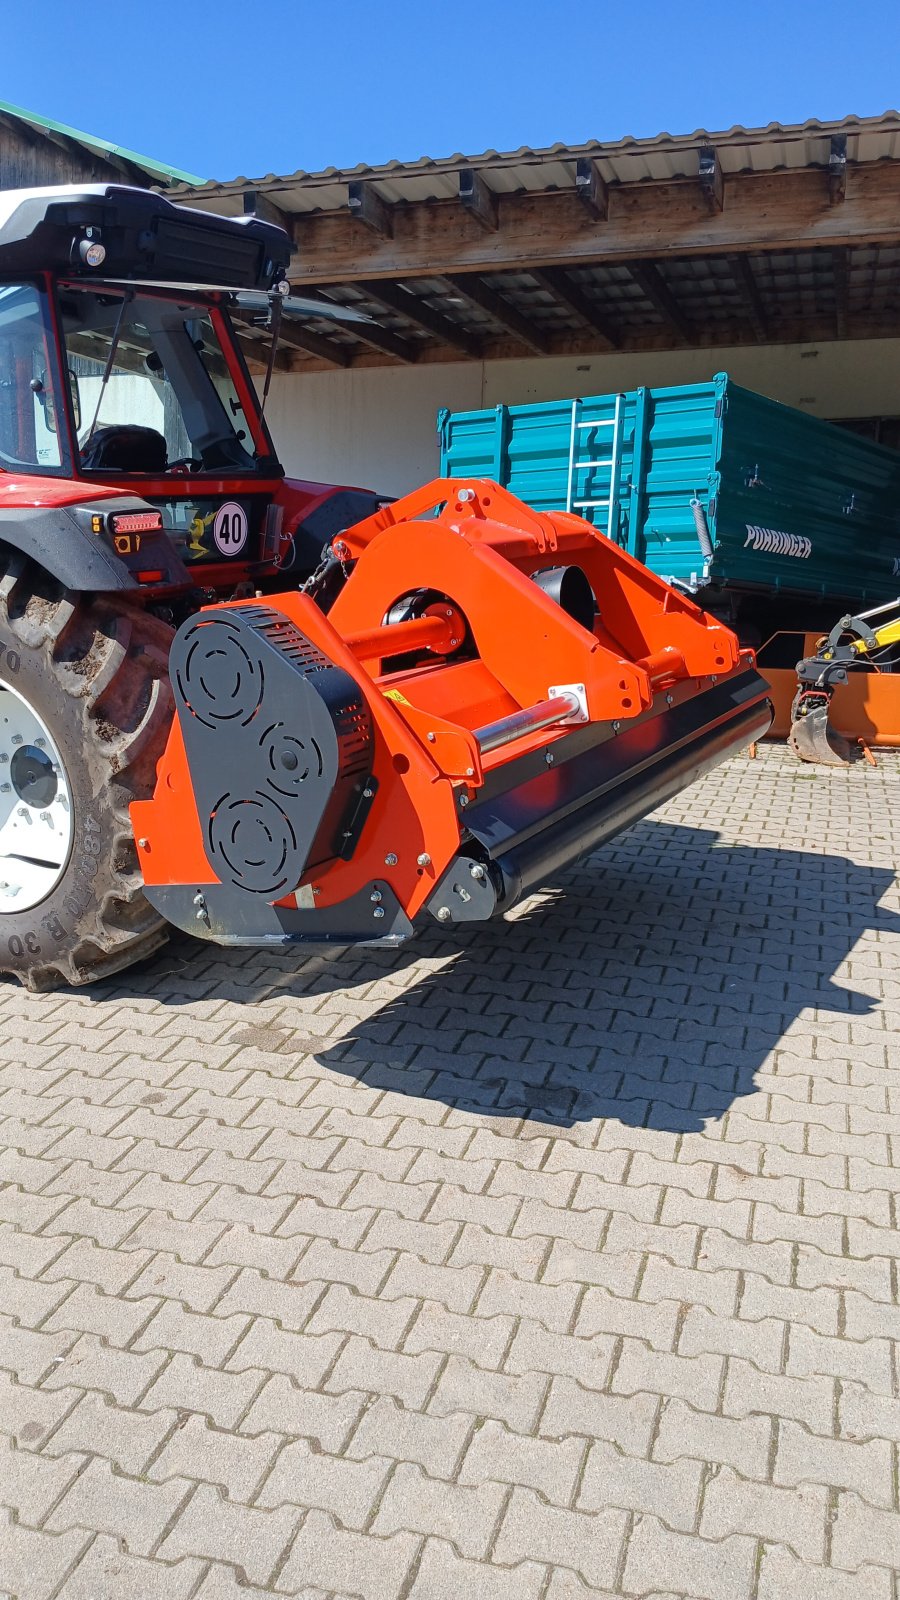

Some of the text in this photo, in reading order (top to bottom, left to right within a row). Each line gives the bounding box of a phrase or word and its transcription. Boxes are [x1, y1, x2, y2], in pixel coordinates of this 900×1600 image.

[219, 513, 242, 544] 40
[42, 911, 68, 942] R
[8, 931, 41, 958] 30
